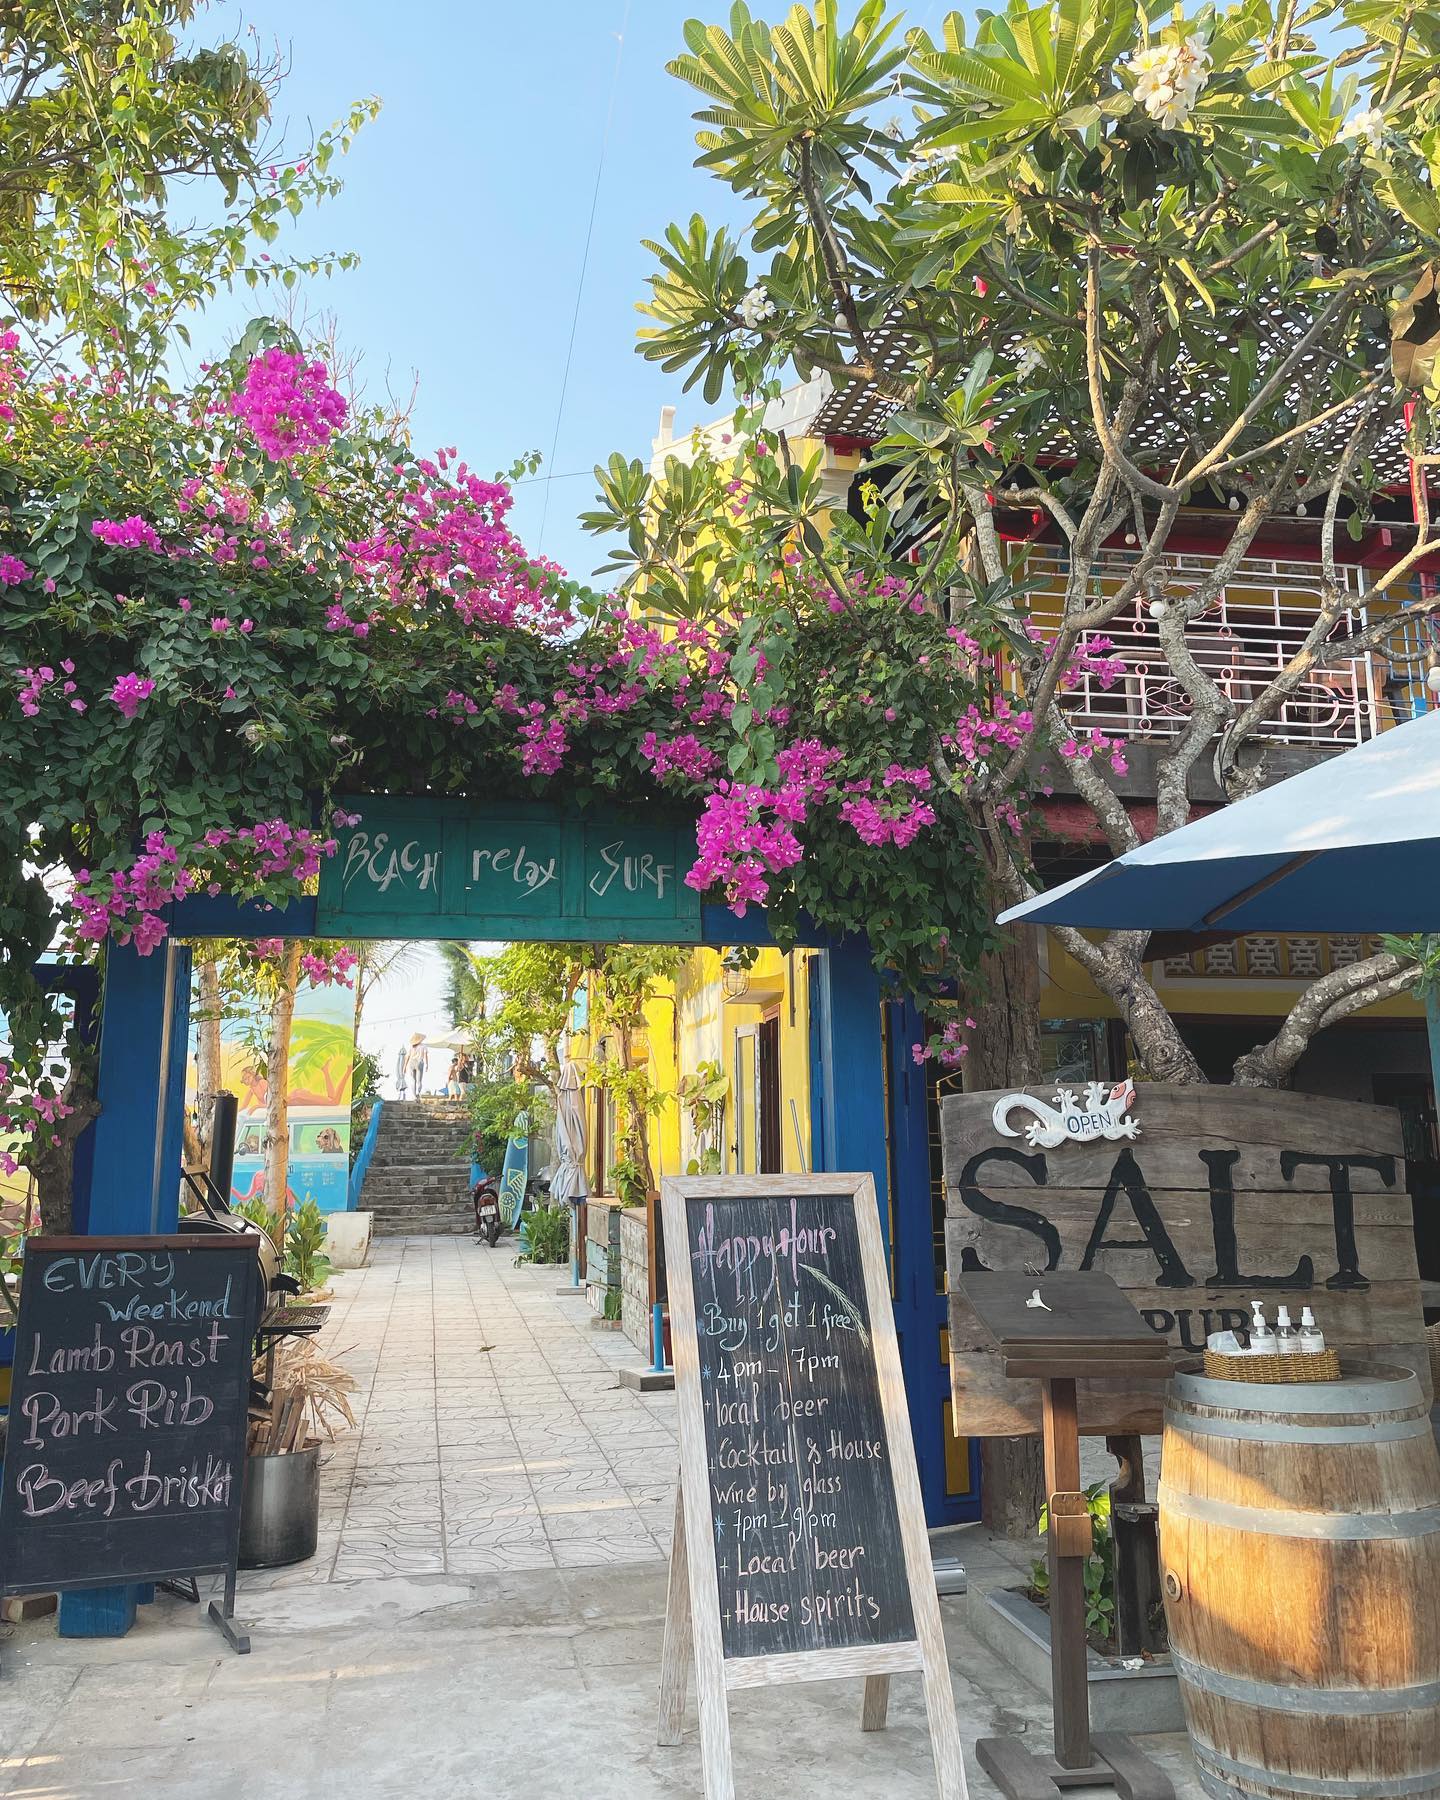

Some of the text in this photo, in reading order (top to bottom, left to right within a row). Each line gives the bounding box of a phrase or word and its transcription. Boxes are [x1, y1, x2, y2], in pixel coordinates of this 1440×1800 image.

[343, 832, 675, 899] BEACH relax SURF
[1067, 1110, 1112, 1134] OPEN
[959, 1146, 1397, 1290] SALT
[692, 1198, 836, 1306] Happy Hour
[27, 1320, 230, 1376] Lamb Roast
[703, 1290, 856, 1353] Buy 1 get 1 free
[1140, 1308, 1252, 1354] PUB
[791, 1346, 839, 1383] 7pm
[21, 1376, 215, 1450] Pork Rib
[773, 1381, 829, 1421] beer
[826, 1428, 883, 1460] House
[16, 1458, 124, 1517] Beef
[767, 1470, 789, 1519] by
[803, 1463, 842, 1517] glass
[737, 1530, 797, 1577] Local
[814, 1536, 866, 1570] beer
[735, 1589, 790, 1625] House
